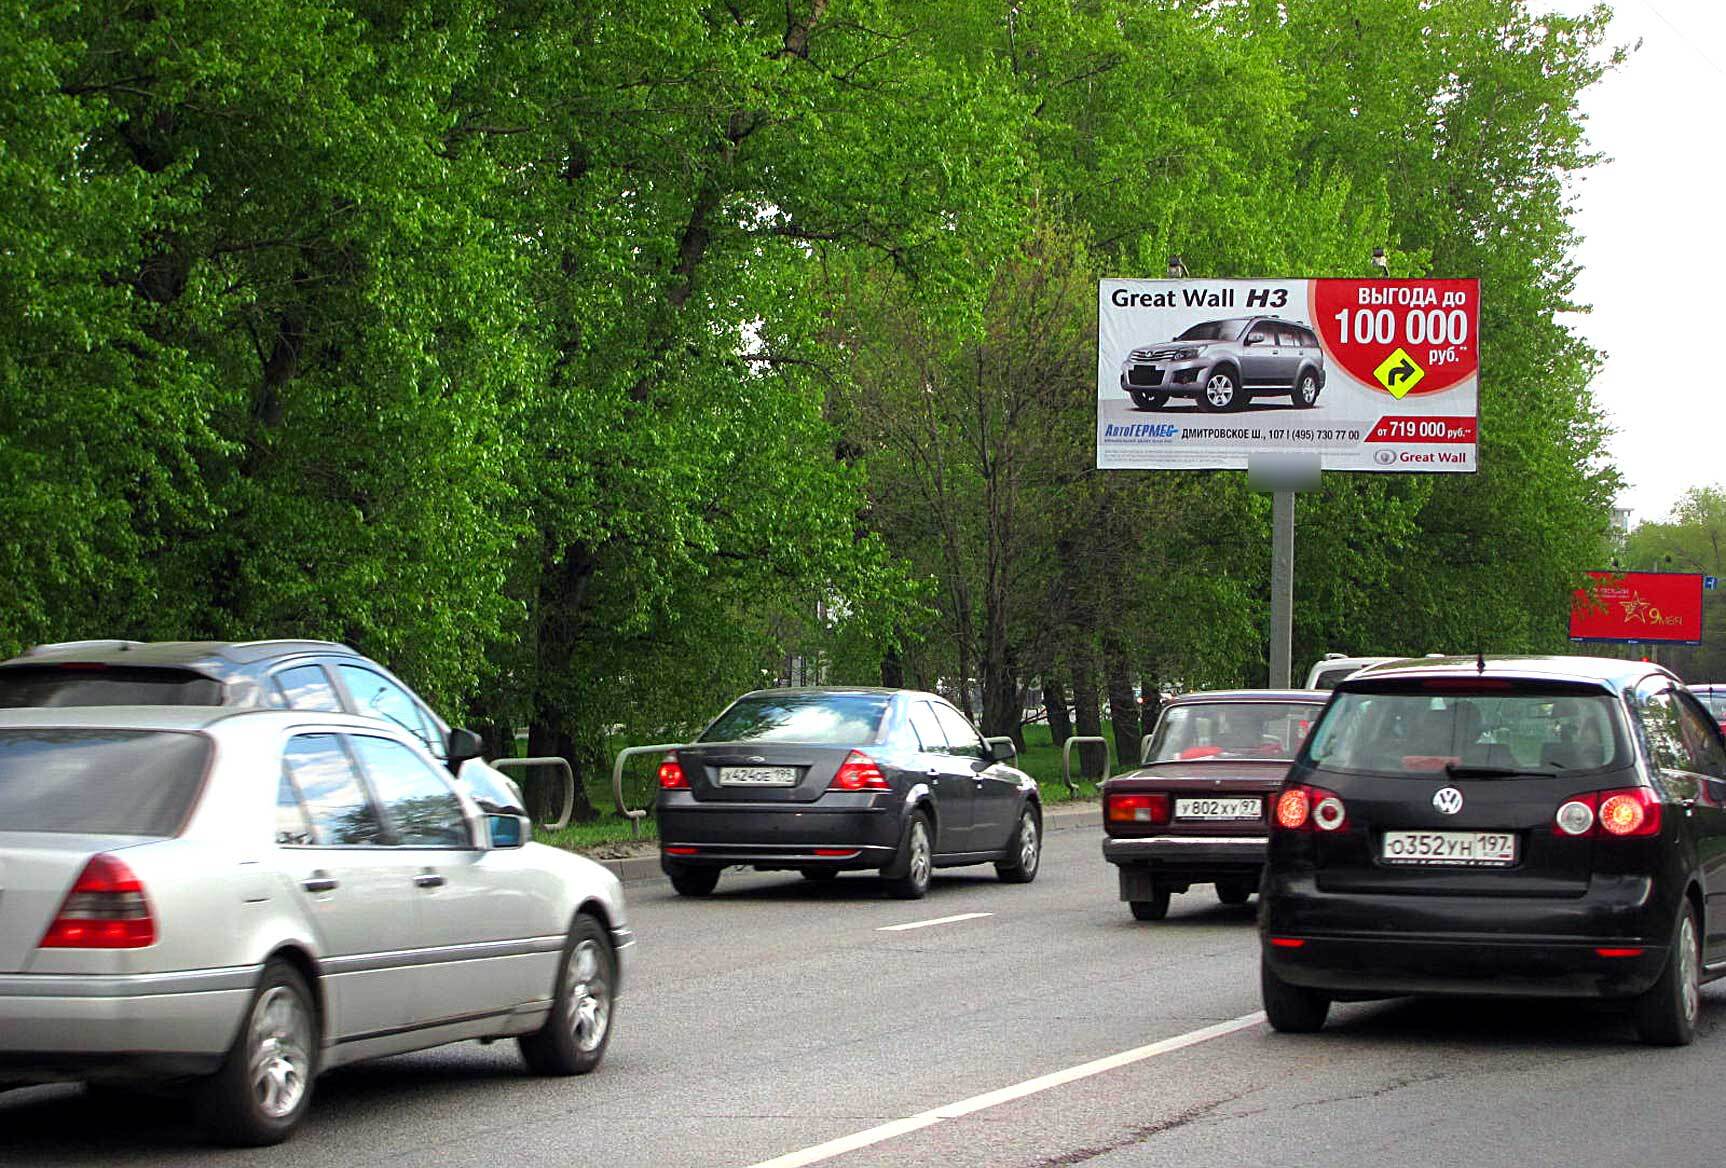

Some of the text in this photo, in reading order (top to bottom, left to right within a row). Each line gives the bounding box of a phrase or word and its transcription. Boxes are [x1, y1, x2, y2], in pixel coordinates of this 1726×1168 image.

[1112, 288, 1289, 308] Great Wall H3
[1358, 287, 1466, 307] ВЫГОДА до
[1335, 308, 1468, 345] 100 000
[1181, 428, 1249, 439] ДМИТРОВСКОЕ
[1269, 429, 1285, 439] 107
[1291, 430, 1315, 441] (495)
[1317, 430, 1333, 440] 730
[1335, 430, 1346, 440] 77
[1348, 430, 1360, 440] 00
[1377, 428, 1388, 436] от
[1389, 421, 1416, 437] 719
[1419, 421, 1446, 437] 000
[1400, 452, 1466, 463] Great Wall
[1649, 607, 1660, 624] 9
[1241, 800, 1257, 811] 97
[1477, 835, 1509, 851] 197
